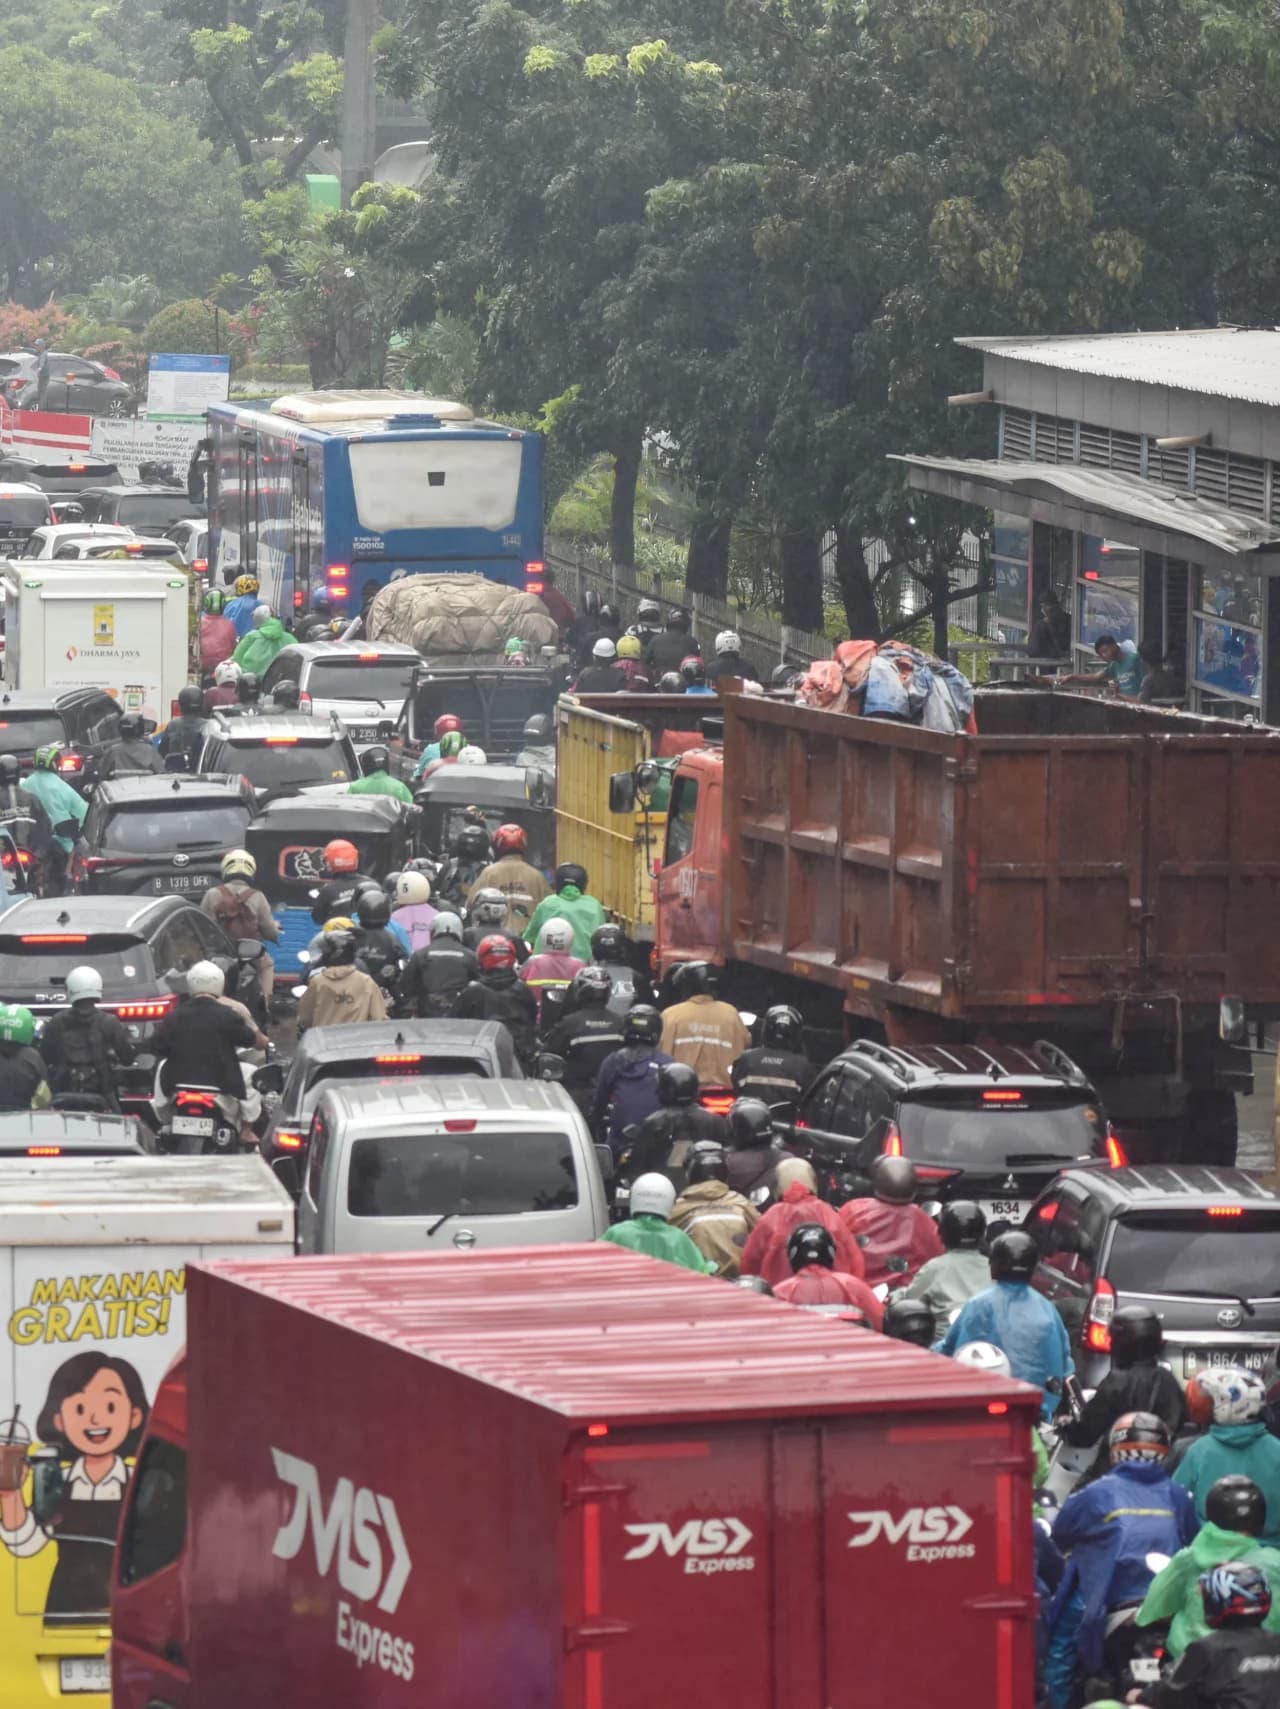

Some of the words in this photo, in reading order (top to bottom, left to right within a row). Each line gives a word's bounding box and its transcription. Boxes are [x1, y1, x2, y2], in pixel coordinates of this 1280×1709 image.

[80, 649, 119, 657] DHARMA
[121, 649, 141, 659] JAYA
[156, 879, 161, 888] B
[170, 877, 189, 888] 1379
[991, 1202, 1020, 1214] 1634
[31, 1269, 186, 1304] MAKANAN
[8, 1297, 172, 1346] GRATIS!
[907, 1543, 975, 1563] Express
[684, 1556, 755, 1576] Express
[336, 1600, 414, 1681] Express
